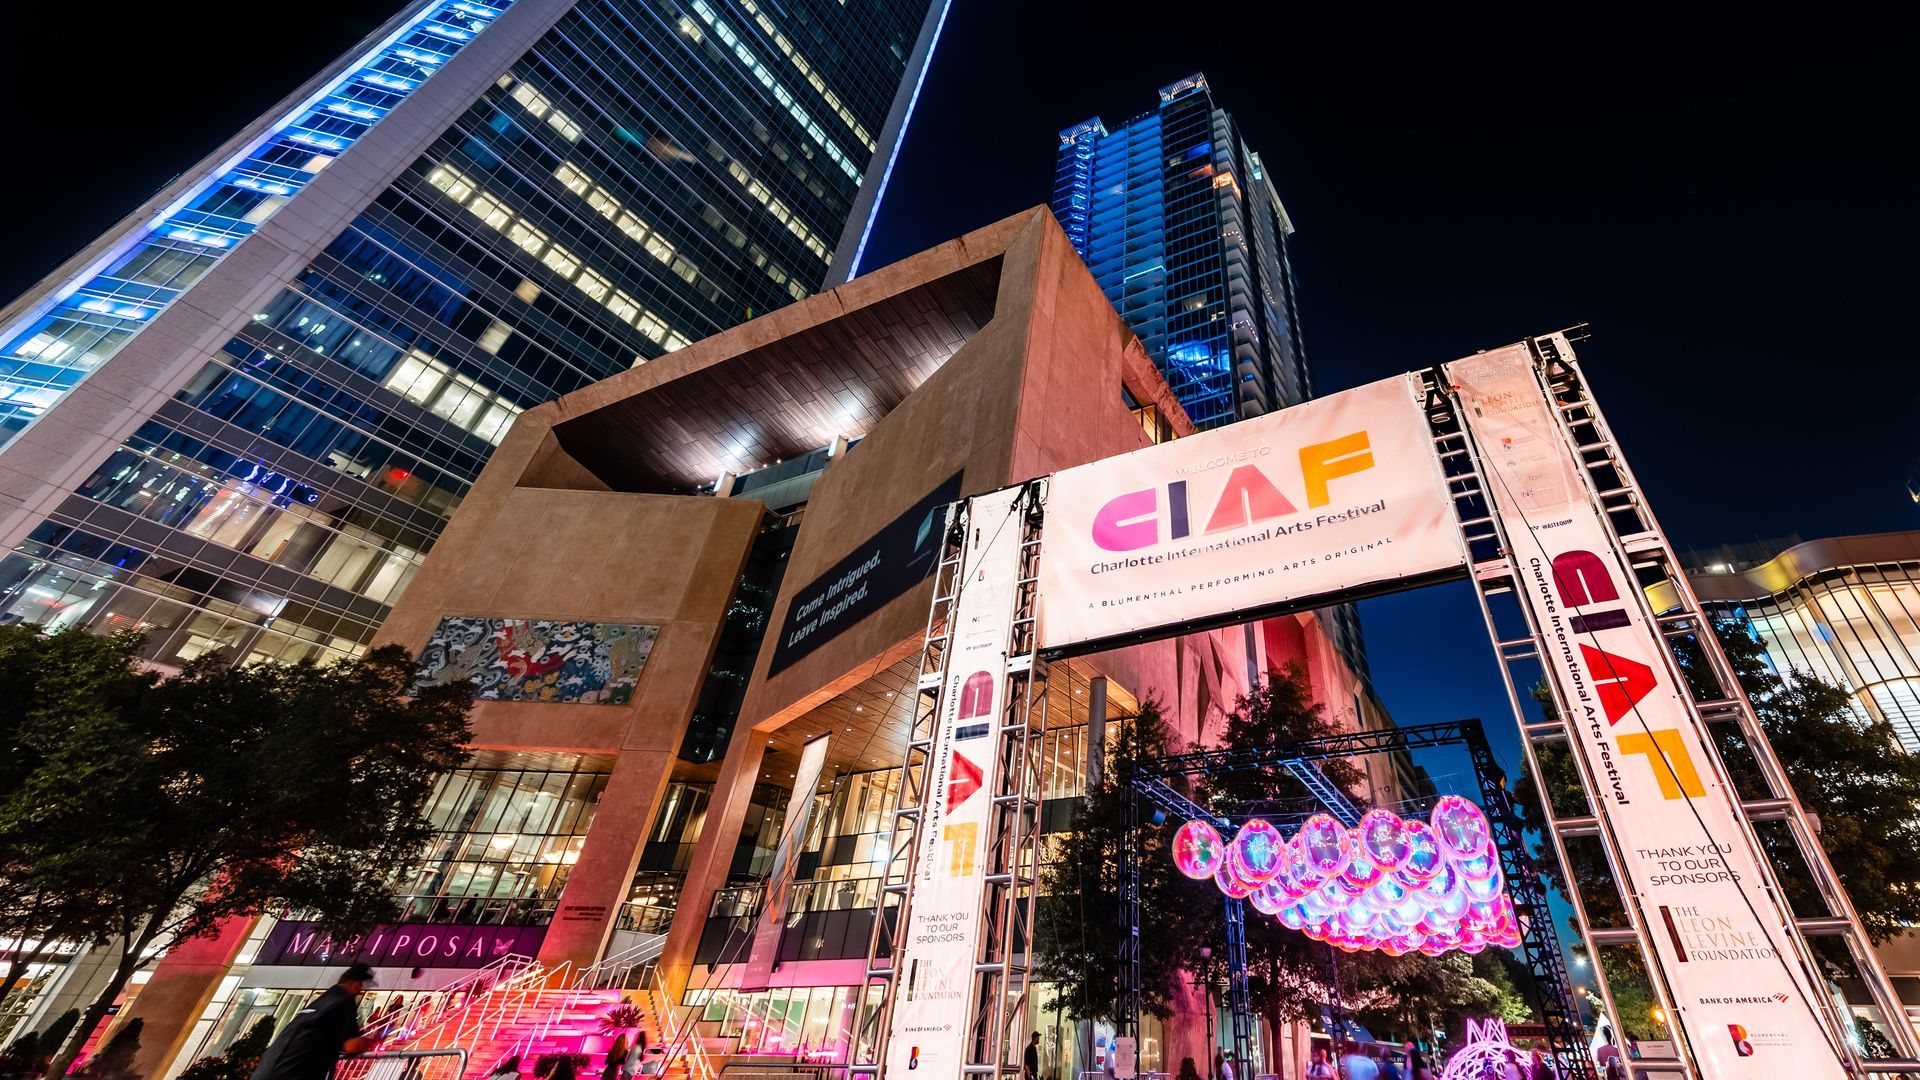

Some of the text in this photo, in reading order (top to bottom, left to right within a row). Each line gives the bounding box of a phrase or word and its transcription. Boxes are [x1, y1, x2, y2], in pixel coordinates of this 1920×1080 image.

[1176, 446, 1271, 476] WELCOME TO
[1092, 430, 1375, 552] CIAF
[1090, 499, 1386, 575] Charlotte International Arts Festival
[1101, 588, 1183, 607] BLUMENTHAL
[1191, 568, 1275, 591] PERFORMING
[1283, 558, 1316, 571] ARTS
[1324, 537, 1392, 561] ORIGINAL
[796, 593, 826, 622] Come
[826, 550, 881, 601] Intrigued.
[788, 580, 868, 648] Leave Inspired.
[1530, 557, 1630, 805] Charlotte International Arts Festival
[1552, 550, 1707, 800] CIAF
[948, 675, 960, 723] Charlotte
[935, 726, 952, 798] International
[943, 670, 994, 878] CIAF
[932, 801, 942, 828] Arts
[1636, 843, 1732, 860] THANK YOU
[1658, 858, 1721, 871] TO OUR
[1650, 870, 1741, 886] SPONSORS
[918, 912, 969, 923] THANK YOU
[1673, 906, 1700, 917] THE
[926, 923, 959, 933] TO OUR
[1680, 917, 1732, 933] LEON
[916, 933, 965, 944] SPONSORS
[1685, 931, 1759, 949] LEVINE
[1690, 947, 1782, 961] FOUNDATION
[915, 991, 962, 1001] FOUNDATION
[1699, 997, 1722, 1005] BANK
[1735, 996, 1773, 1005] AMERICA
